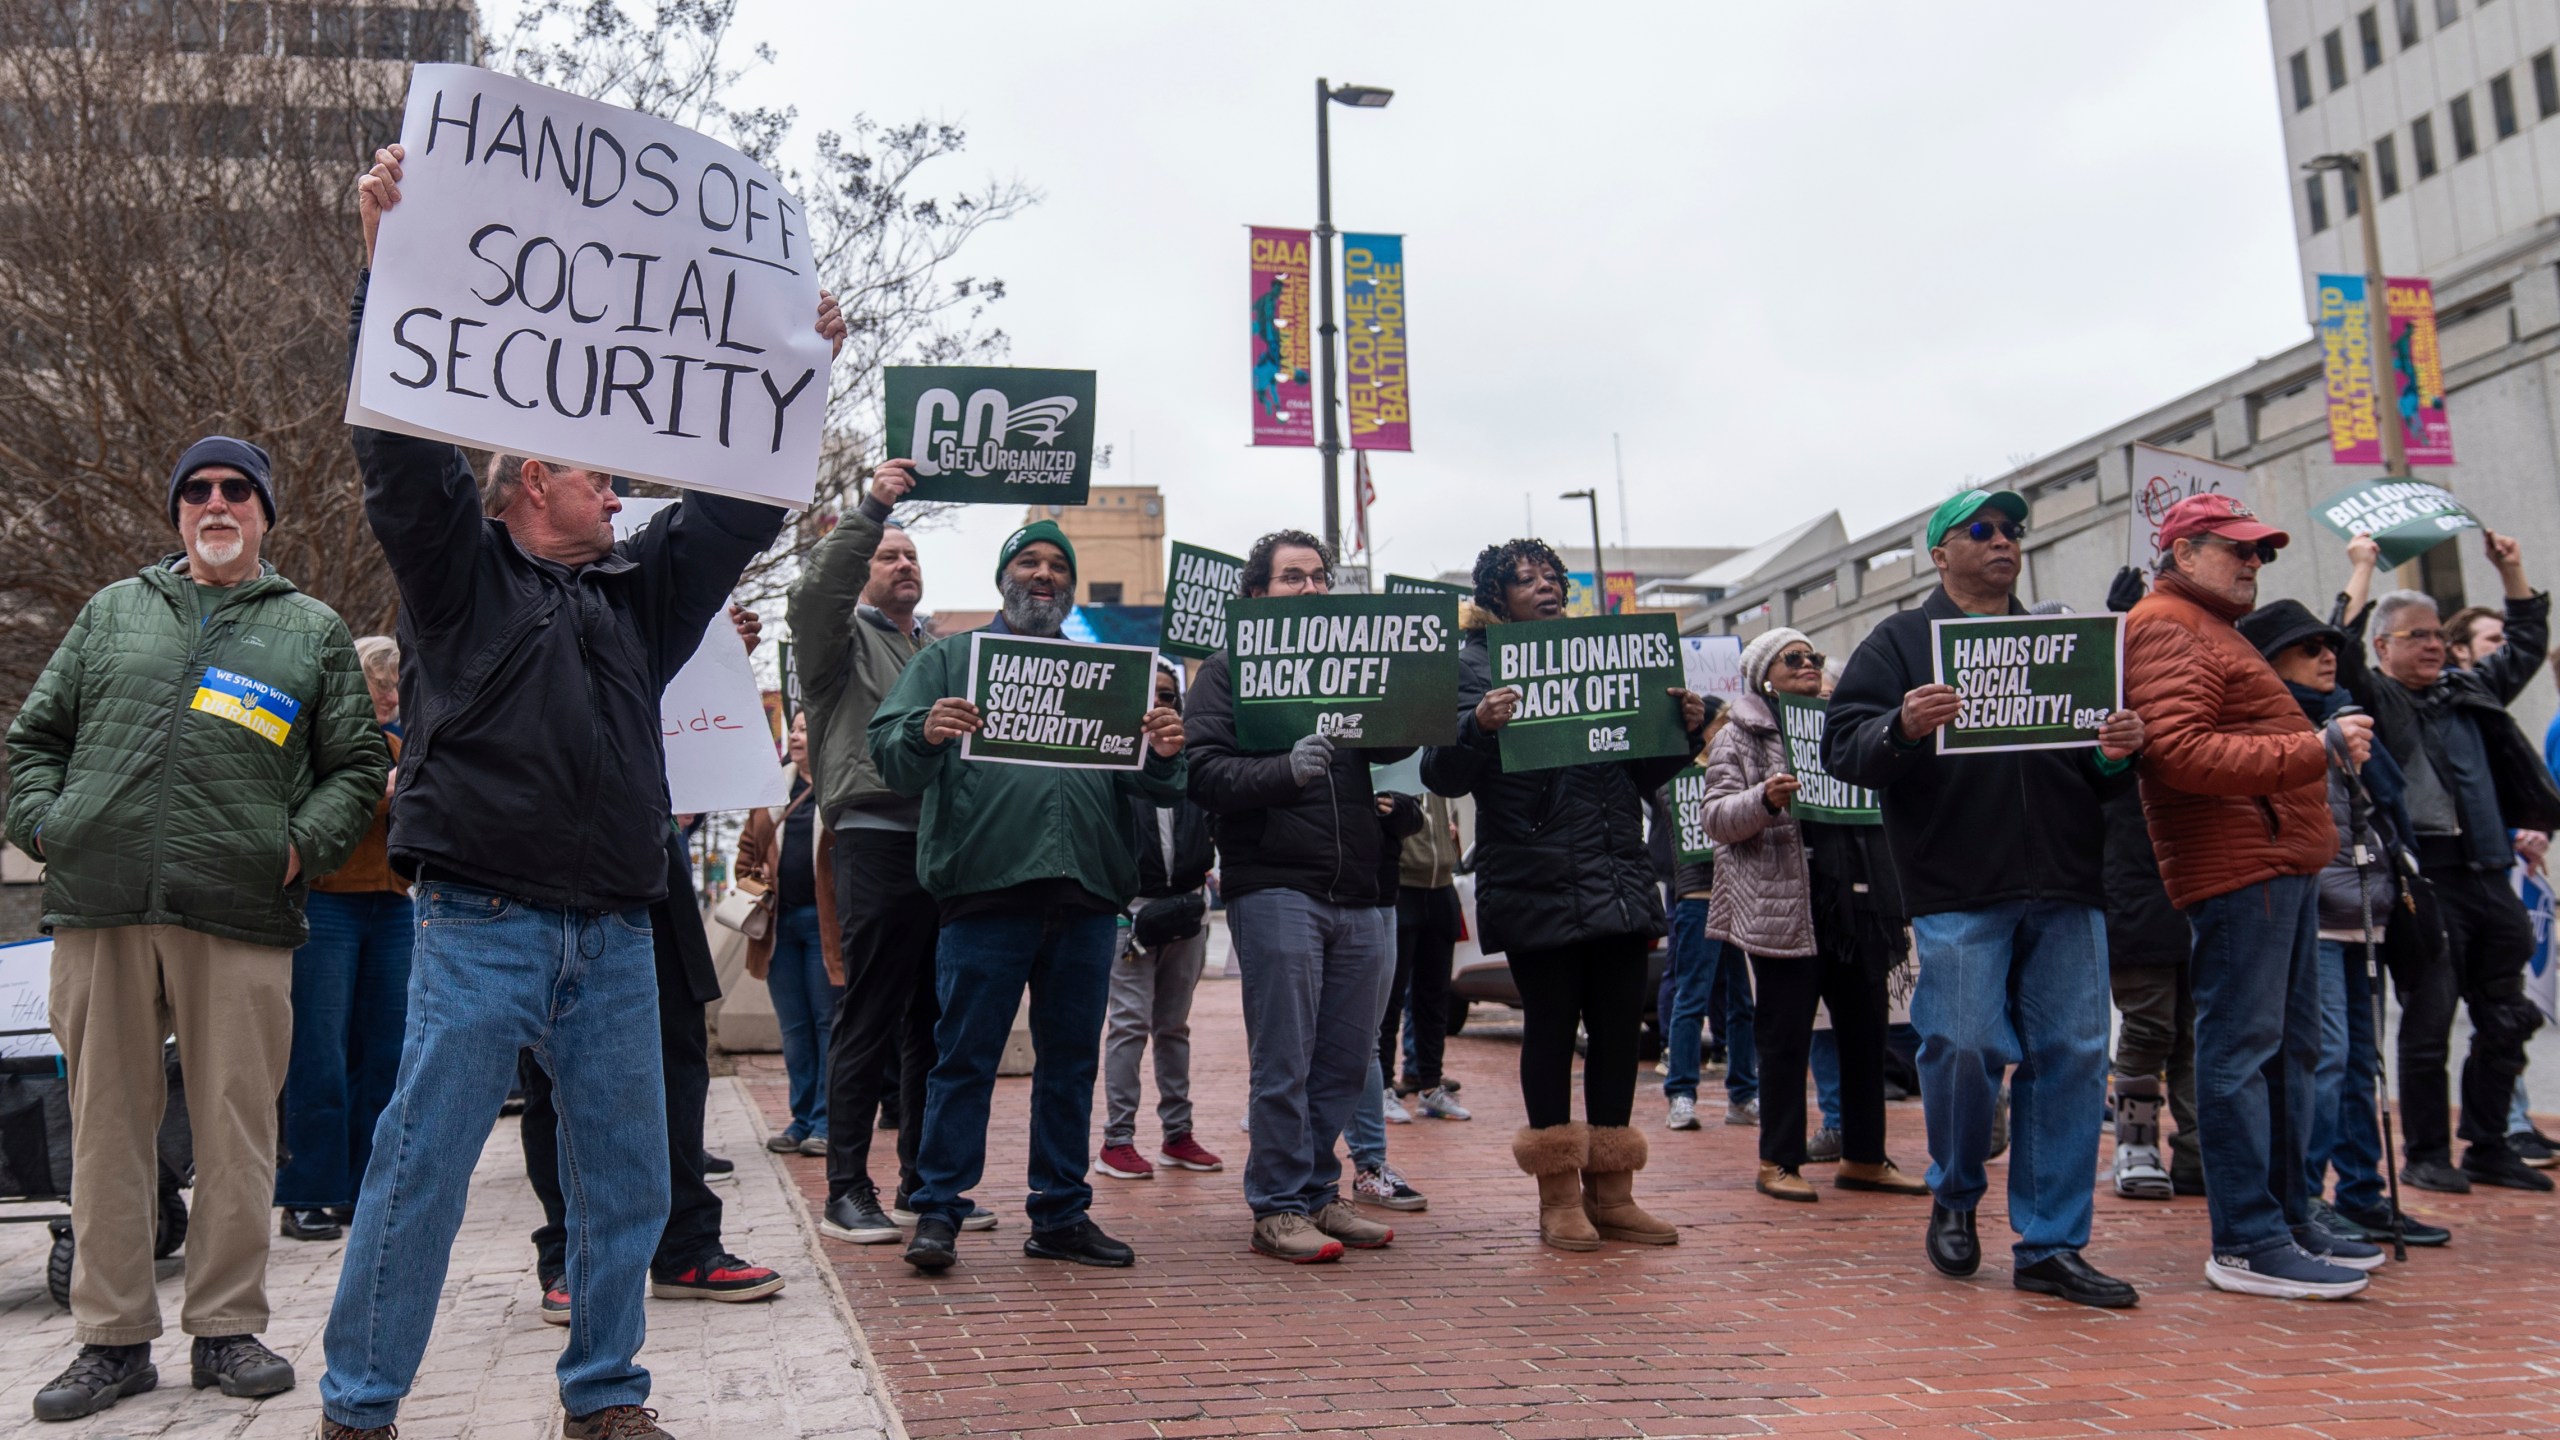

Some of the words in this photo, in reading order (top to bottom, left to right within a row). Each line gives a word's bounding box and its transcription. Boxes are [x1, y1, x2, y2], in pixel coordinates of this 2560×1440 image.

[426, 90, 679, 216] HANDS
[698, 162, 797, 260] OFF
[1251, 238, 1309, 265] CIAA
[1346, 247, 1374, 287] TO
[468, 223, 766, 354] SOCIAL
[2321, 287, 2344, 319] TO
[1374, 262, 1408, 424] BALTIMORE
[389, 307, 815, 454] SECURITY
[1347, 293, 1381, 435] WELCOME
[2343, 302, 2378, 440] BALTIMORE
[2324, 326, 2357, 452] WELCOME
[910, 387, 1009, 477] GO
[939, 438, 977, 470] GET
[982, 439, 1077, 472] ORGANIZED
[1003, 470, 1073, 485] AFSCME
[2347, 499, 2418, 537] BACK
[1175, 552, 1245, 596] HANDS
[1167, 611, 1228, 650] SECU
[1236, 614, 1448, 656] BILLIONAIRES:
[1501, 632, 1675, 680] BILLIONAIRES:
[1954, 634, 2031, 669] HANDS
[2033, 633, 2078, 664] OFF
[216, 669, 233, 683] WE
[232, 675, 268, 694] STAND
[270, 688, 294, 708] WITH
[988, 653, 1070, 687] HANDS
[1070, 660, 1115, 691] OFF
[1240, 658, 1314, 697] BACK
[1319, 657, 1390, 695] OFF!
[1708, 674, 1742, 692] LOVE
[1955, 666, 2033, 698] SOCIAL
[986, 682, 1066, 716] SOCIAL
[1507, 677, 1579, 719] BACK
[1585, 673, 1640, 711] OFF!
[1954, 694, 2073, 729] SECURITY!
[200, 696, 281, 741] UKRAINE
[983, 711, 1103, 747] SECURITY!
[1316, 712, 1344, 738] GO
[1589, 726, 1612, 752] GO
[2217, 1255, 2250, 1271] HOKA
